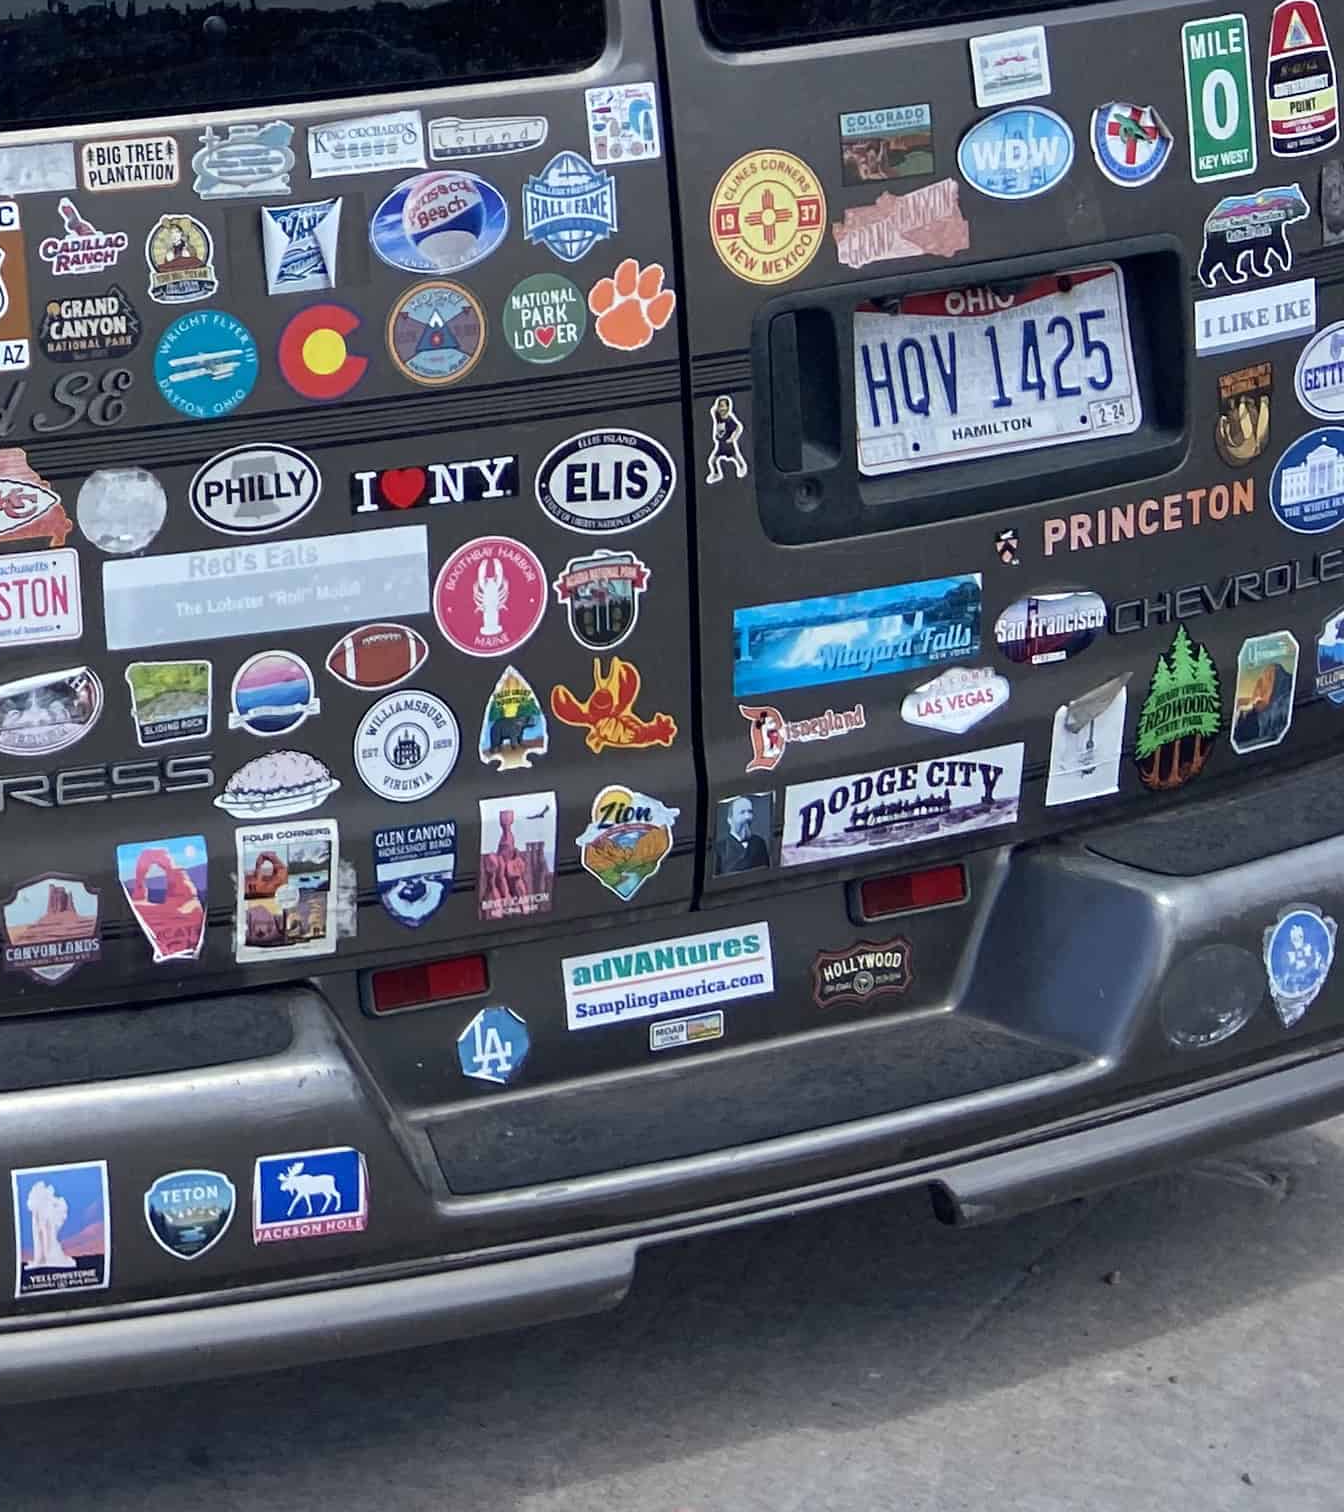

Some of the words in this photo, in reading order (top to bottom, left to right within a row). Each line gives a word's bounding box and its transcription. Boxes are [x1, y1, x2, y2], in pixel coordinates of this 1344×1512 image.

[1189, 28, 1242, 59] MILE
[847, 107, 925, 128] COLORADO
[1202, 68, 1239, 140] 0
[1288, 97, 1317, 115] POINT
[96, 145, 123, 167] BIG
[126, 141, 164, 164] TREE
[971, 136, 1060, 172] WDW
[1198, 153, 1221, 170] KEY
[1220, 149, 1249, 166] WEST
[88, 162, 175, 188] PLANTATION
[723, 162, 758, 201] CLINES
[760, 158, 811, 194] CORNERS
[417, 196, 469, 230] Beach
[530, 196, 562, 219] HALL
[574, 191, 609, 215] FAME
[719, 211, 736, 229] 19
[801, 204, 818, 221] 37
[897, 184, 958, 232] CANYON
[39, 234, 127, 257] CADILLAC
[726, 239, 759, 272] NEW
[761, 232, 813, 275] MEXICO
[848, 218, 898, 268] GRAND
[55, 248, 116, 273] RANCH
[61, 296, 120, 319] GRAND
[511, 287, 577, 310] NATIONAL
[49, 315, 127, 340] CANYON
[521, 306, 568, 328] PARK
[1202, 318, 1213, 339] I
[1217, 307, 1270, 336] LIKE
[1275, 298, 1312, 324] IKE
[47, 337, 101, 353] NATIONAL
[104, 334, 132, 347] PARK
[159, 314, 210, 355] WRIGHT
[212, 313, 250, 345] FLYER
[2, 343, 27, 366] AZ
[861, 330, 958, 428] HQV
[984, 309, 1113, 409] 1425
[32, 367, 134, 433] SE
[213, 388, 247, 416] OHIO
[577, 434, 602, 449] ELLIS
[602, 433, 638, 447] ISLAND
[951, 416, 1033, 441] HAMILTON
[204, 469, 308, 507] PHILLY
[354, 470, 380, 513] I
[565, 459, 649, 504] ELIS
[1043, 477, 1256, 557] PRINCETON
[1283, 504, 1301, 519] THE
[1302, 496, 1332, 514] WHITE
[188, 549, 258, 579] Red's
[264, 544, 319, 569] Eats
[444, 547, 495, 592] BOOTHBAY
[497, 545, 538, 584] HARBOR
[176, 600, 203, 617] The
[207, 594, 264, 613] Lobster
[995, 618, 1027, 644] San
[1029, 608, 1105, 639] Francisco
[473, 634, 511, 648] MAINE
[819, 637, 914, 674] Niagara
[919, 621, 973, 663] Falls
[915, 694, 944, 718] LAS
[946, 687, 995, 711] VEGAS
[1143, 693, 1217, 734] REDWOODS
[143, 719, 179, 737] SLIDING
[180, 716, 205, 731] ROCK
[366, 698, 448, 738] WILLIAMSBURG
[381, 770, 435, 791] VIRGINIA
[596, 800, 654, 830] Zion
[796, 764, 920, 848] DODGE
[925, 759, 1006, 805] CITY
[241, 830, 275, 844] FOUR
[274, 827, 332, 841] CORNERS
[375, 831, 407, 849] GLEN
[407, 822, 457, 844] CANYON
[378, 841, 429, 858] HORSESHOE
[428, 838, 453, 851] BEND
[509, 891, 551, 907] CANYON
[5, 938, 101, 963] CANYONLANDS
[571, 932, 761, 987] adVANtures
[823, 951, 902, 982] HOLLYWOOD
[575, 970, 765, 1019] Samplingamerica.com
[654, 1022, 686, 1038] MOAB
[472, 1014, 512, 1075] LA
[160, 1185, 220, 1204] TETON
[256, 1223, 323, 1242] JACKSON
[325, 1217, 363, 1231] HOLE
[29, 1269, 97, 1284] YELLOWSTONE
